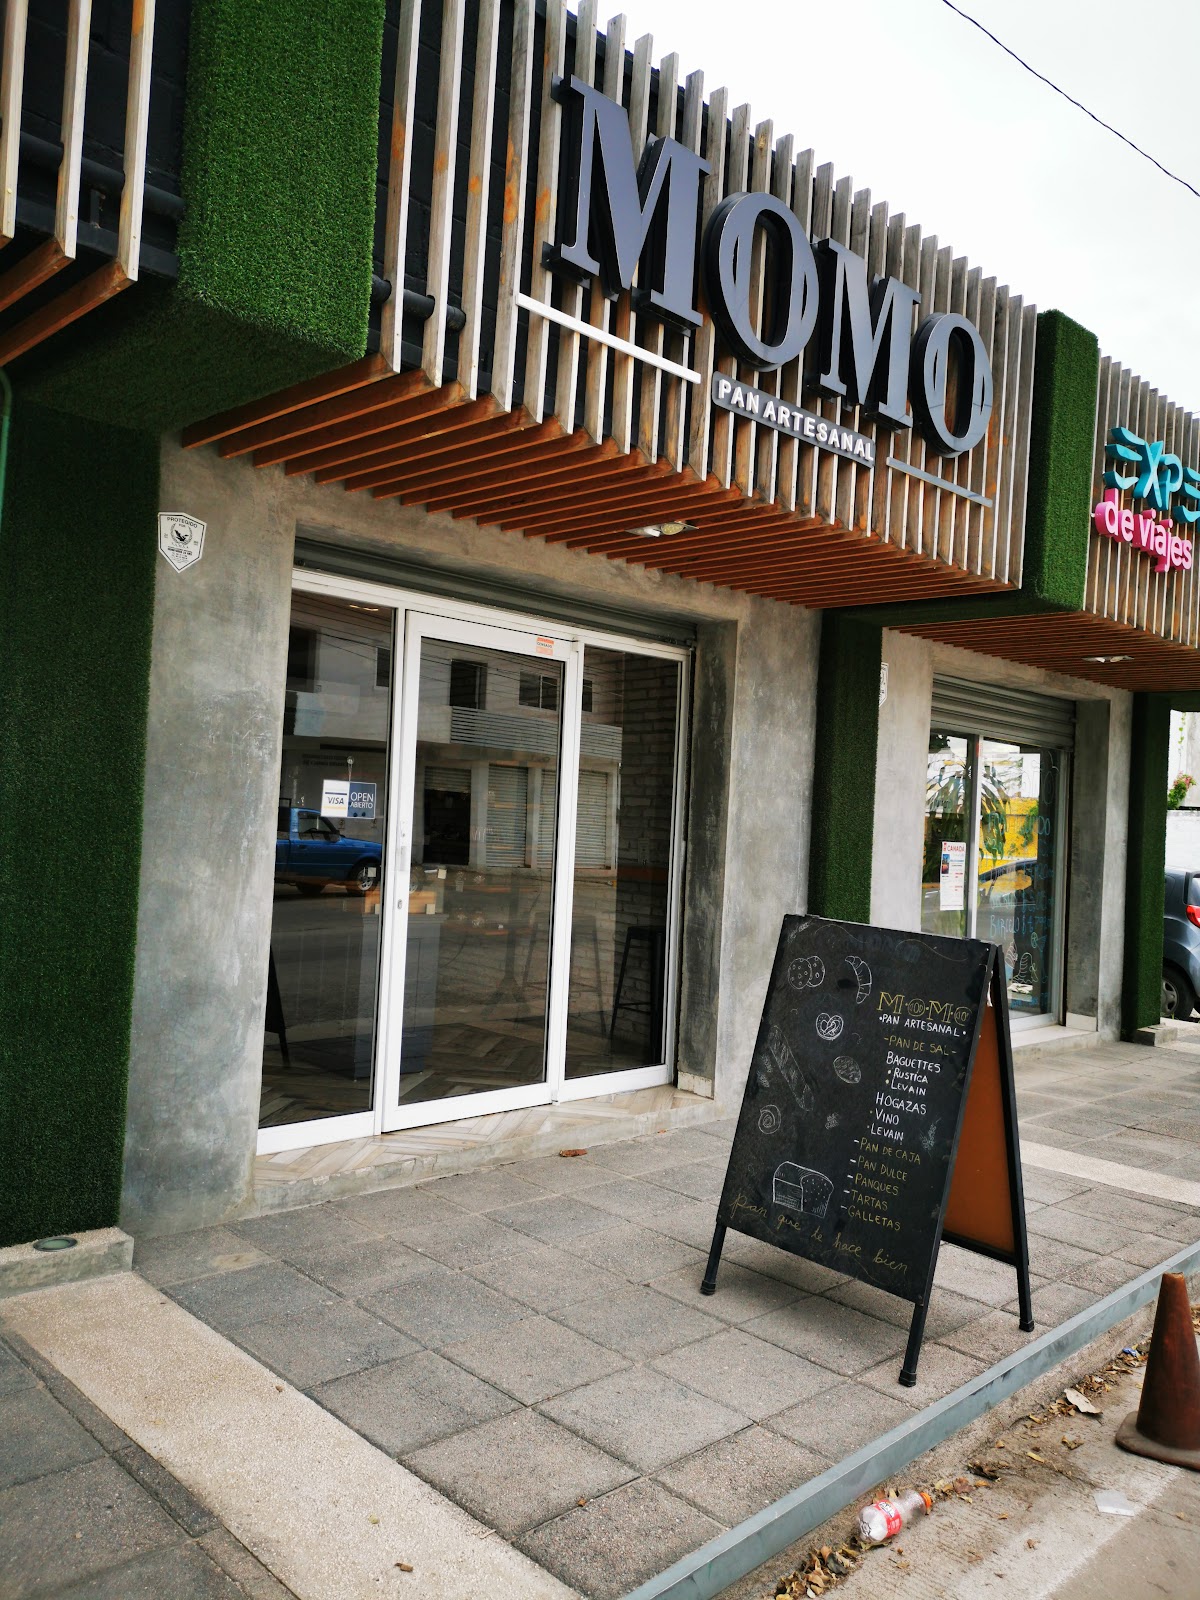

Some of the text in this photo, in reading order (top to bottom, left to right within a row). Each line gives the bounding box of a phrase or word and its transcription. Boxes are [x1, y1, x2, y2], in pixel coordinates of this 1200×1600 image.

[543, 73, 993, 458] MOMO
[718, 379, 874, 461] PAN ARTESANAL
[1095, 488, 1193, 572] de viajes
[328, 797, 345, 805] VISA
[350, 792, 374, 802] OPEN
[882, 1013, 960, 1037] PAN ARTESANAL
[913, 1041, 925, 1052] DE
[886, 1051, 941, 1073] BAGUETTES
[891, 1077, 926, 1096] LEVAIN
[875, 1091, 927, 1115] HOGAZAS
[875, 1108, 899, 1125] VINO
[870, 1123, 904, 1141] LEVAIN
[883, 1146, 892, 1157] DE
[895, 1150, 921, 1165] CAJA
[880, 1163, 908, 1181] DULCE
[855, 1172, 899, 1196] PANQUES
[851, 1189, 888, 1211] TARTAS
[847, 1205, 901, 1231] GALLETAS
[777, 1214, 801, 1230] que
[811, 1226, 823, 1242] te
[833, 1232, 862, 1257] hace
[873, 1248, 908, 1274] bien
